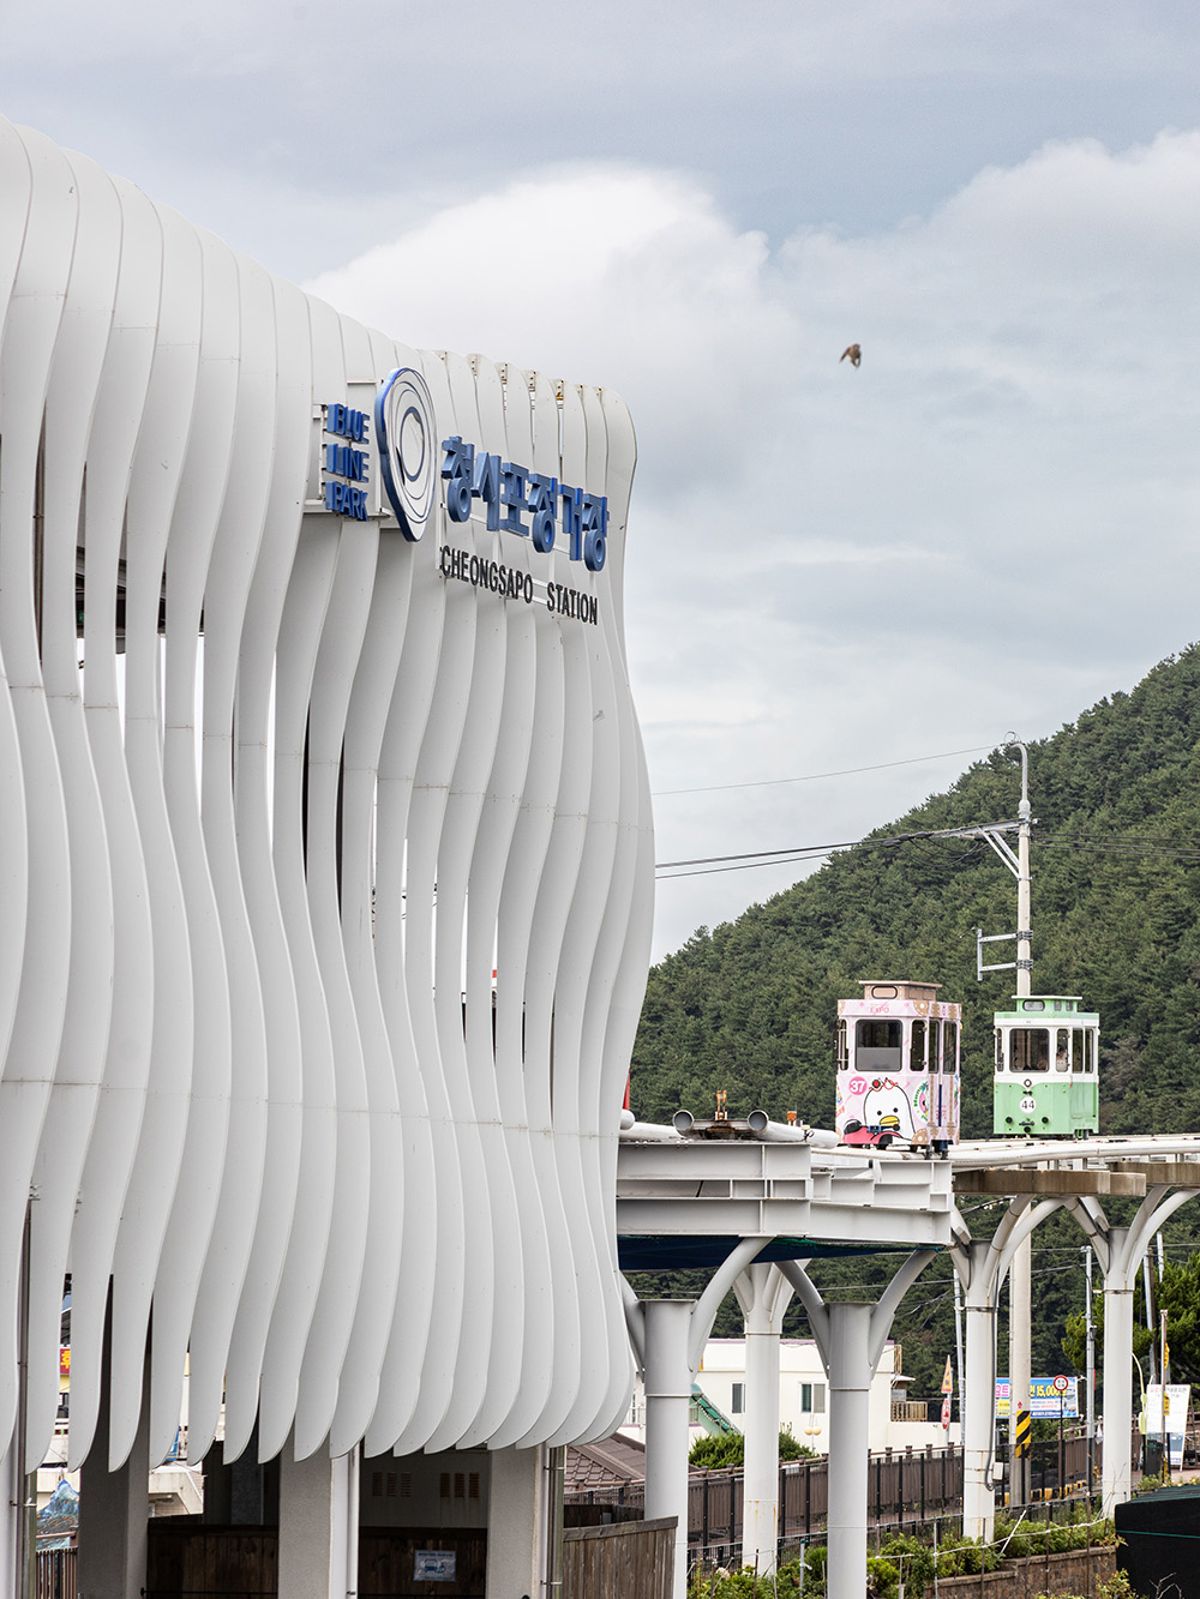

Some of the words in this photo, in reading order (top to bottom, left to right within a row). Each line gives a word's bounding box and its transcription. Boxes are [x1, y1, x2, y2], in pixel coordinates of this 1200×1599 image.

[327, 403, 370, 444] BLUE
[326, 443, 370, 483] LINE
[325, 481, 369, 521] PARK
[442, 435, 610, 571] 청사포정거장
[440, 545, 533, 604] CHEONGSAPO
[546, 582, 598, 625] STATION
[849, 1083, 865, 1093] 37
[1021, 1100, 1034, 1109] 44
